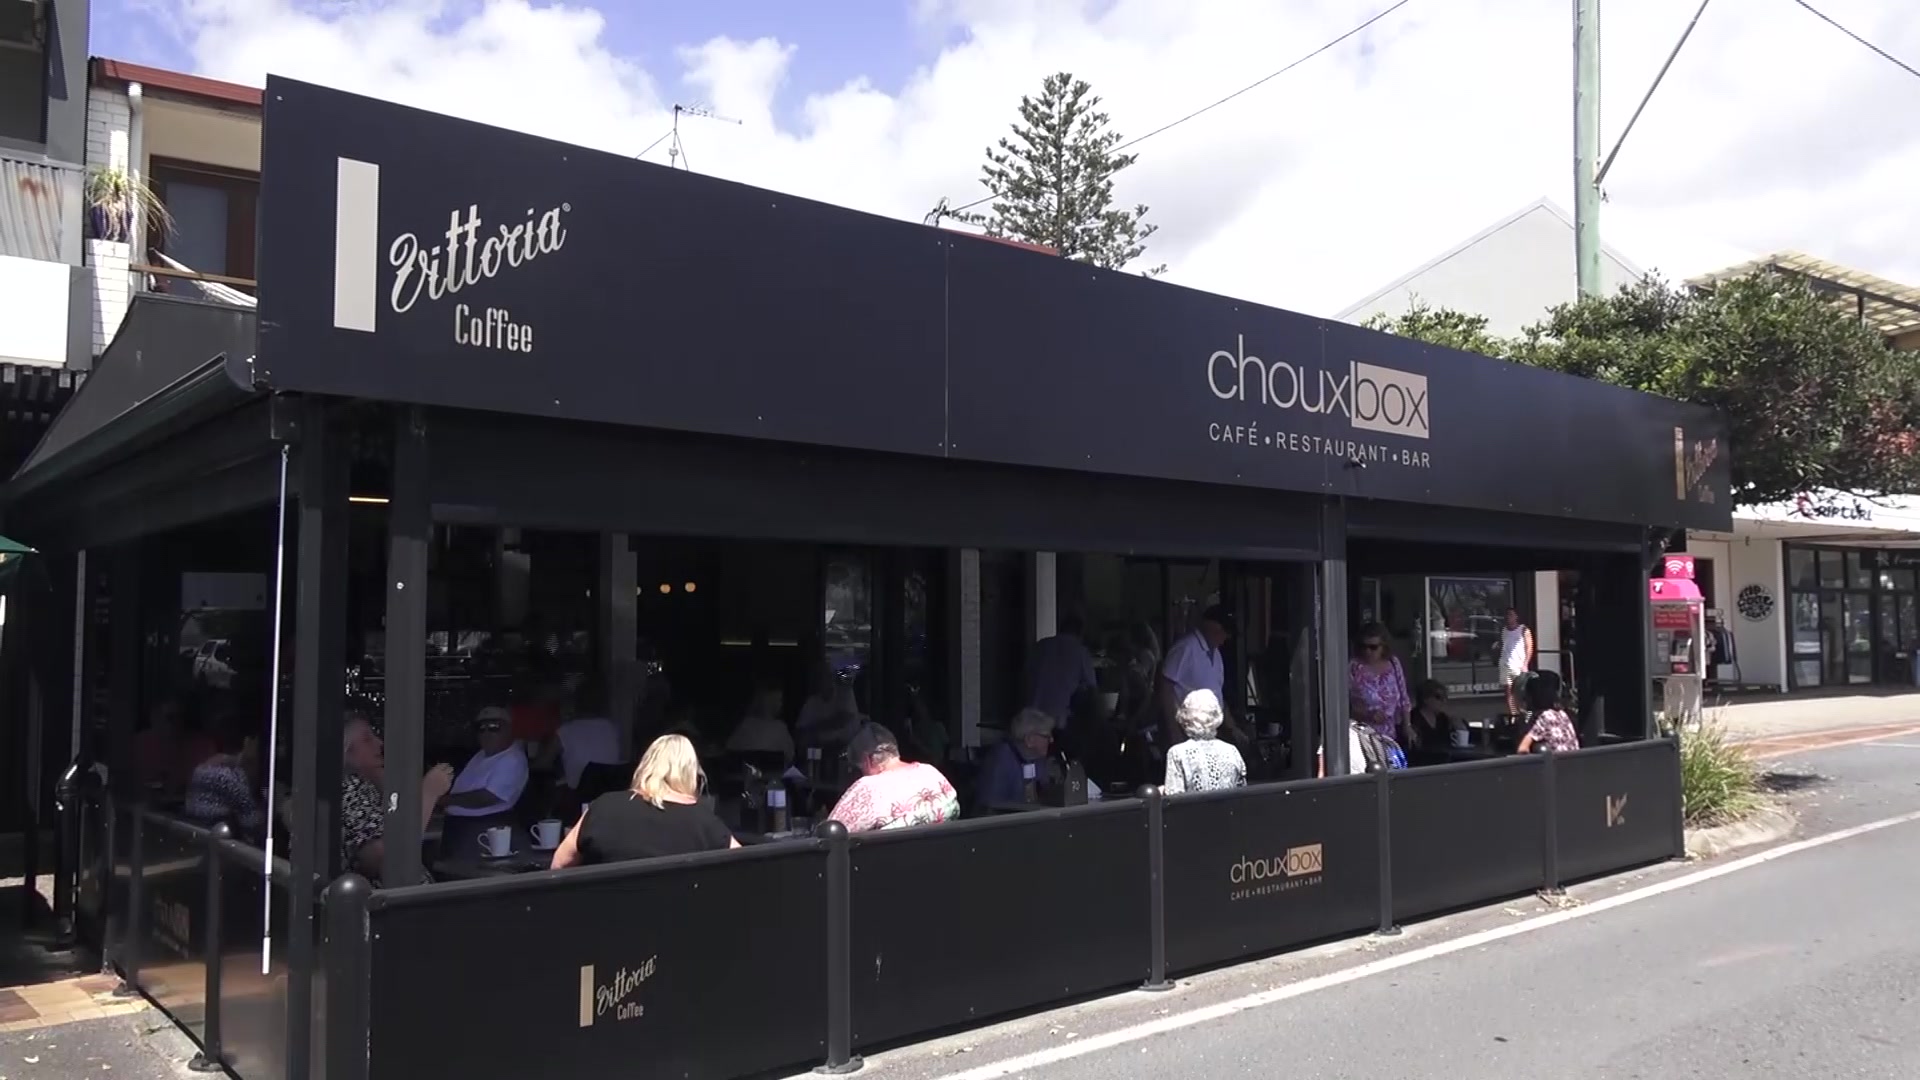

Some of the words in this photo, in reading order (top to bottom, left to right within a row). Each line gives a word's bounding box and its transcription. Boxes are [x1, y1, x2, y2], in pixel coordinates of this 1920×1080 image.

[389, 204, 567, 313] Vittoria
[455, 303, 533, 353] Coffee
[1208, 421, 1258, 447] CAFÉ
[1276, 431, 1388, 463] RESTAURANT
[1402, 450, 1431, 469] BAR
[596, 957, 656, 1016] Vittoria
[617, 1002, 644, 1021] Coffee
